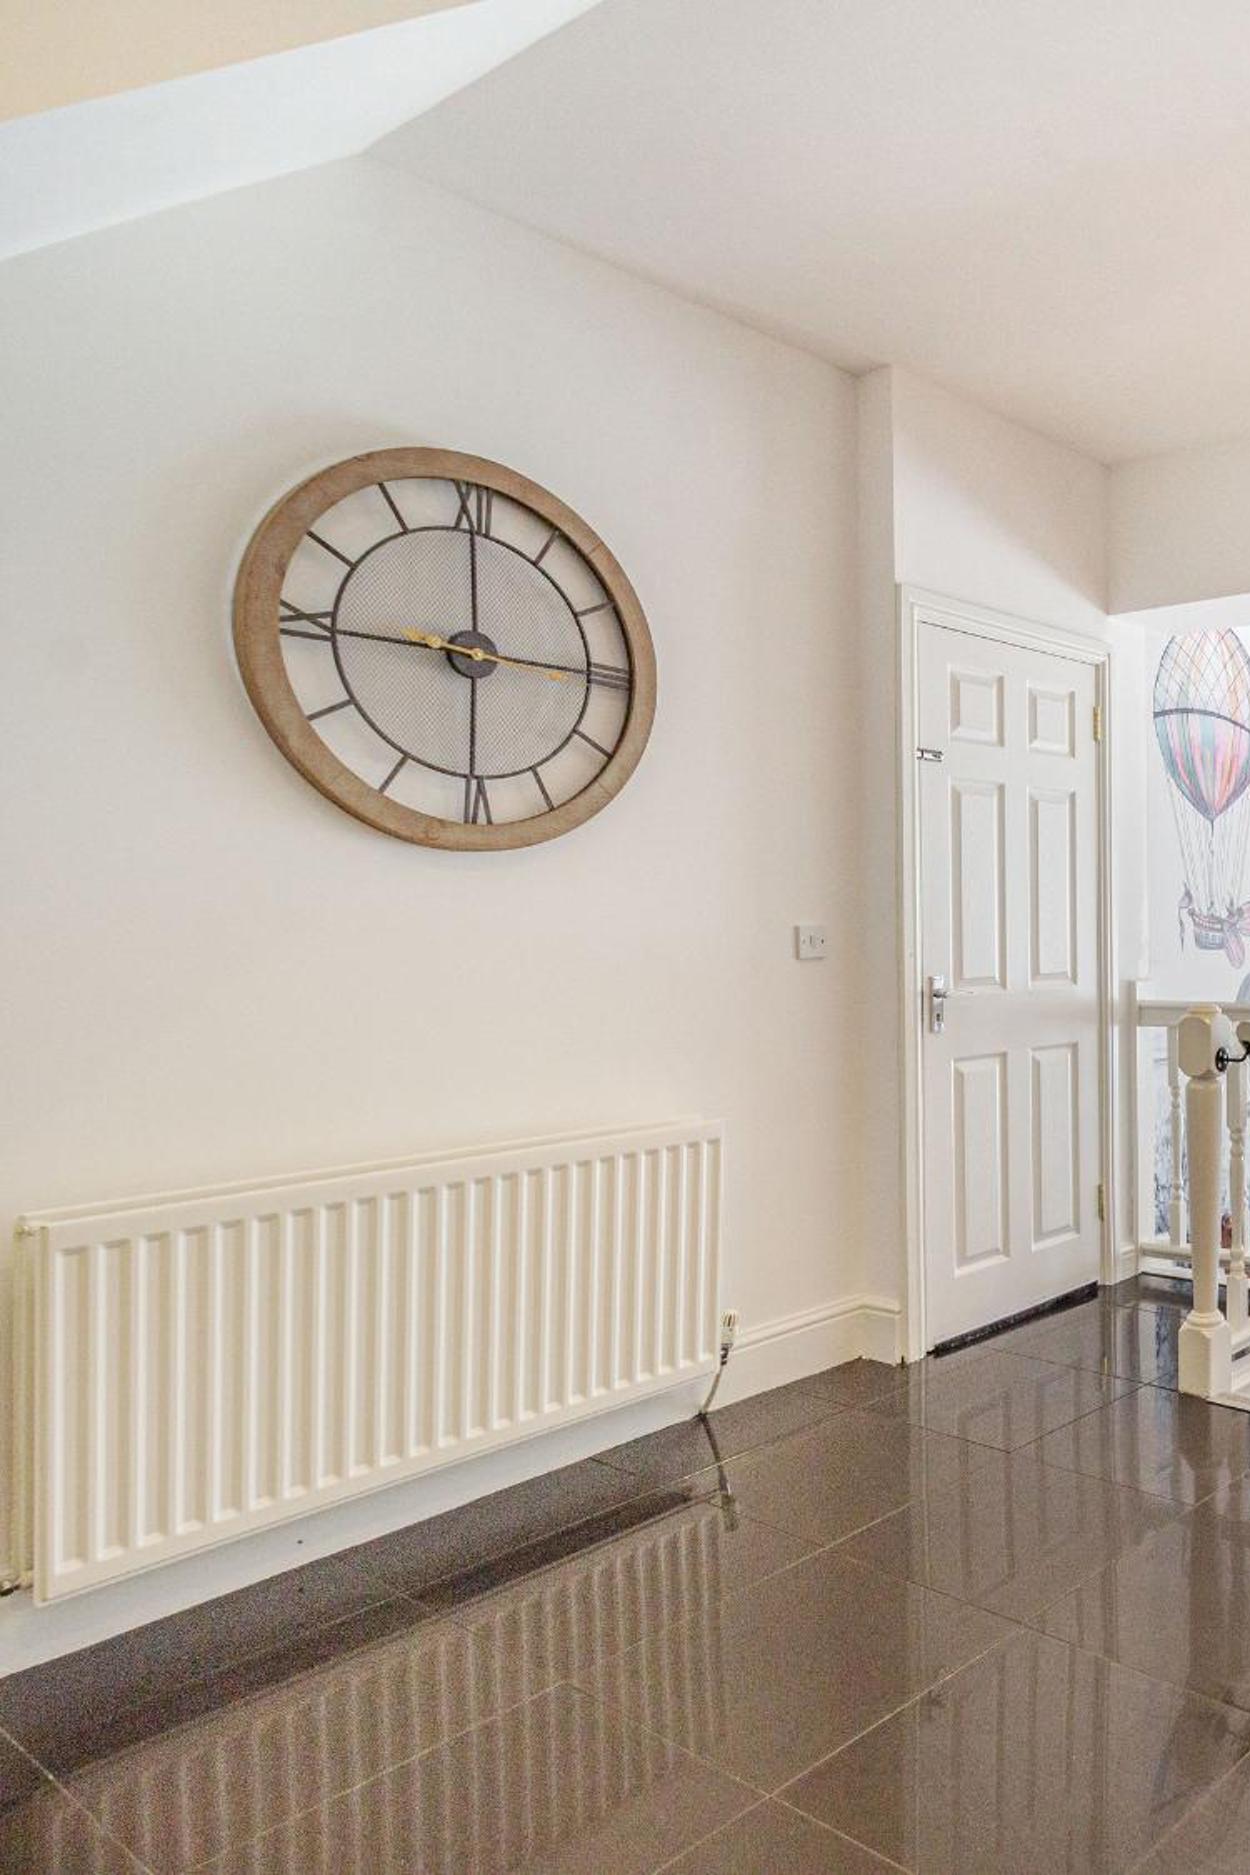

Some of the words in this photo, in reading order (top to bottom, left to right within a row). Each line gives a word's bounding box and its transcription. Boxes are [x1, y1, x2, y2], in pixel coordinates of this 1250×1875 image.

[453, 479, 494, 536] XII
[279, 598, 334, 641] IX
[589, 662, 631, 690] III
[463, 776, 493, 825] VI
